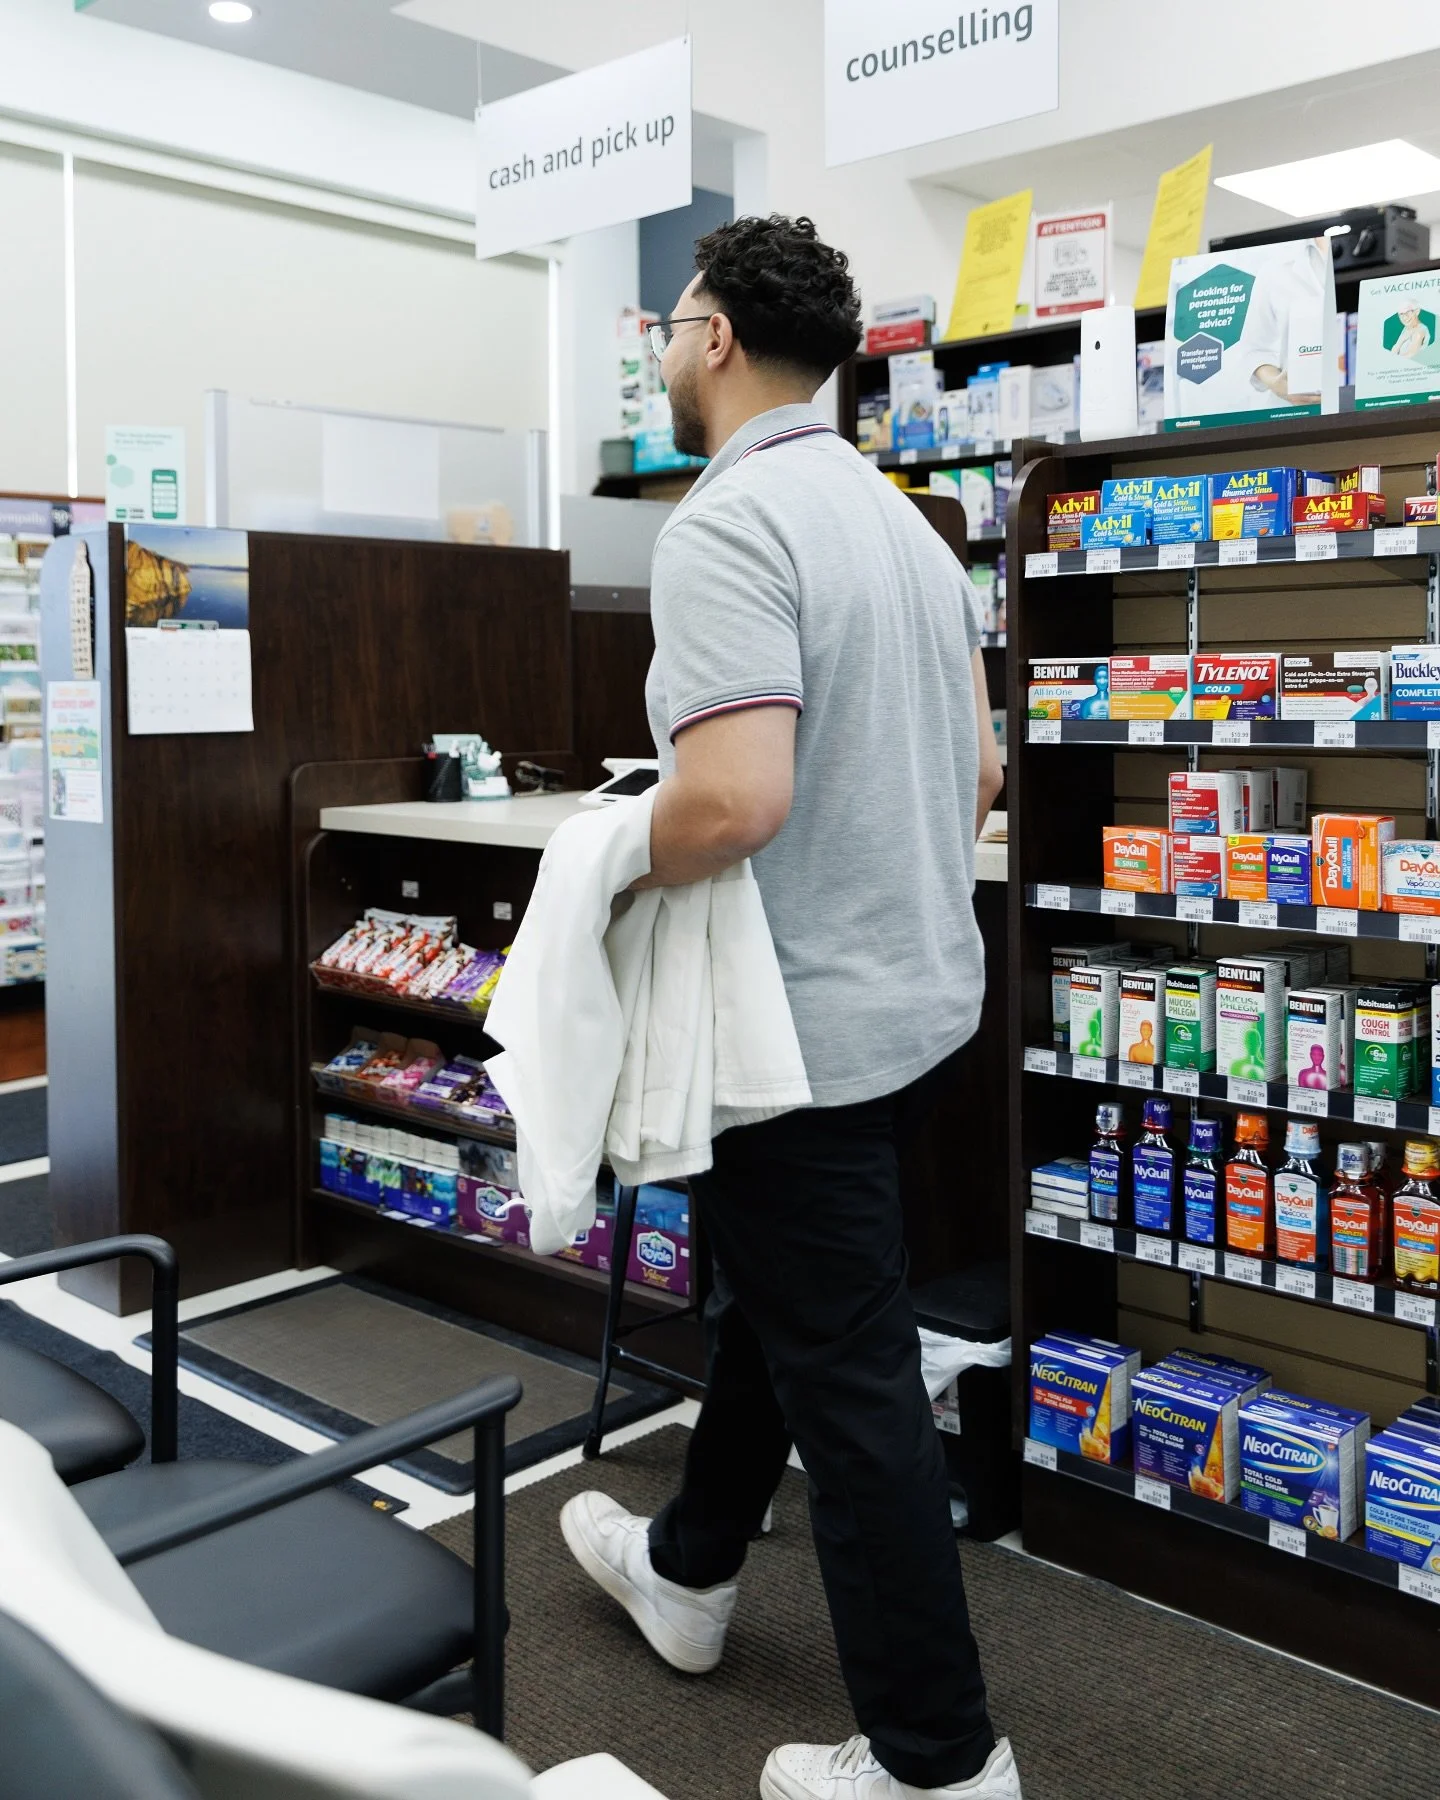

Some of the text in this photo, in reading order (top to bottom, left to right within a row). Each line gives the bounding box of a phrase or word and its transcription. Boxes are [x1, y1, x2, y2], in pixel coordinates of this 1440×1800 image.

[846, 4, 1034, 83] counselling
[489, 113, 675, 189] cash and pick up
[1041, 218, 1100, 235] ATTENTION
[1193, 284, 1244, 298] Looking for
[1189, 294, 1246, 311] personalized
[1197, 306, 1235, 319] care and
[1199, 317, 1232, 330] advice?
[1181, 348, 1218, 358] Transfer your
[1181, 355, 1218, 365] prescriptions
[1225, 471, 1268, 490] Advil
[1341, 471, 1359, 492] Advil
[1112, 480, 1153, 496] Advil
[1154, 481, 1200, 501] Advil
[1222, 489, 1245, 498] Rhume
[1254, 486, 1272, 494] Sinus
[1049, 496, 1095, 514] Advil
[1304, 495, 1353, 513] Advil
[1306, 512, 1324, 520] Cold
[1331, 511, 1350, 519] Sinus
[1090, 514, 1132, 532] Advil
[1033, 665, 1079, 679] BENYLIN
[1197, 663, 1270, 682] TYLENOL
[1352, 670, 1375, 678] Strength
[1034, 688, 1073, 696] All In One
[1205, 685, 1231, 693] COLD
[1113, 841, 1148, 857] DayQuil
[1123, 860, 1139, 868] SINUS
[1232, 851, 1263, 863] DayQuil
[1271, 854, 1300, 864] NyQuil
[1325, 837, 1340, 888] DayQuil
[1258, 913, 1277, 921] $20.99
[1053, 957, 1086, 967] BENYLIN
[1071, 974, 1100, 985] BENYLIN
[1218, 966, 1261, 982] BENYLIN
[1122, 979, 1154, 991] BENYLIN
[1166, 979, 1198, 991] Robitussin
[1071, 992, 1094, 1000] MUCUS
[1071, 998, 1098, 1006] PHLEGM
[1168, 997, 1192, 1008] MUCUS
[1220, 994, 1253, 1004] MUCUS
[1220, 1002, 1258, 1012] PHLEGM
[1289, 1000, 1324, 1014] BENYLIN
[1357, 998, 1396, 1010] Robitussin
[1168, 1006, 1196, 1017] PHLEGM
[1361, 1018, 1390, 1030] COUGH
[1361, 1028, 1391, 1037] CONTROL
[1195, 1128, 1213, 1137] NyQuil
[1090, 1166, 1118, 1181] NyQuil
[1134, 1164, 1170, 1181] NyQuil
[1184, 1186, 1214, 1200] NyQuil
[1226, 1183, 1264, 1200] DayQuil
[1276, 1192, 1313, 1208] DayQuil
[1332, 1217, 1368, 1231] DayQuil
[1395, 1216, 1438, 1233] DayQuil
[640, 1243, 672, 1264] Royale
[1353, 1292, 1373, 1303] $14.99
[1149, 1434, 1184, 1450] TOTAL RHUME
[1152, 1429, 1184, 1443] TOTAL COLD
[1243, 1467, 1283, 1485] TOTAL COLD
[1244, 1474, 1289, 1494] TOTAL RHUME
[1369, 1506, 1385, 1516] COLD
[1407, 1518, 1430, 1530] THROAT
[1410, 1526, 1417, 1534] DE
[1418, 1529, 1436, 1540] GORGE
